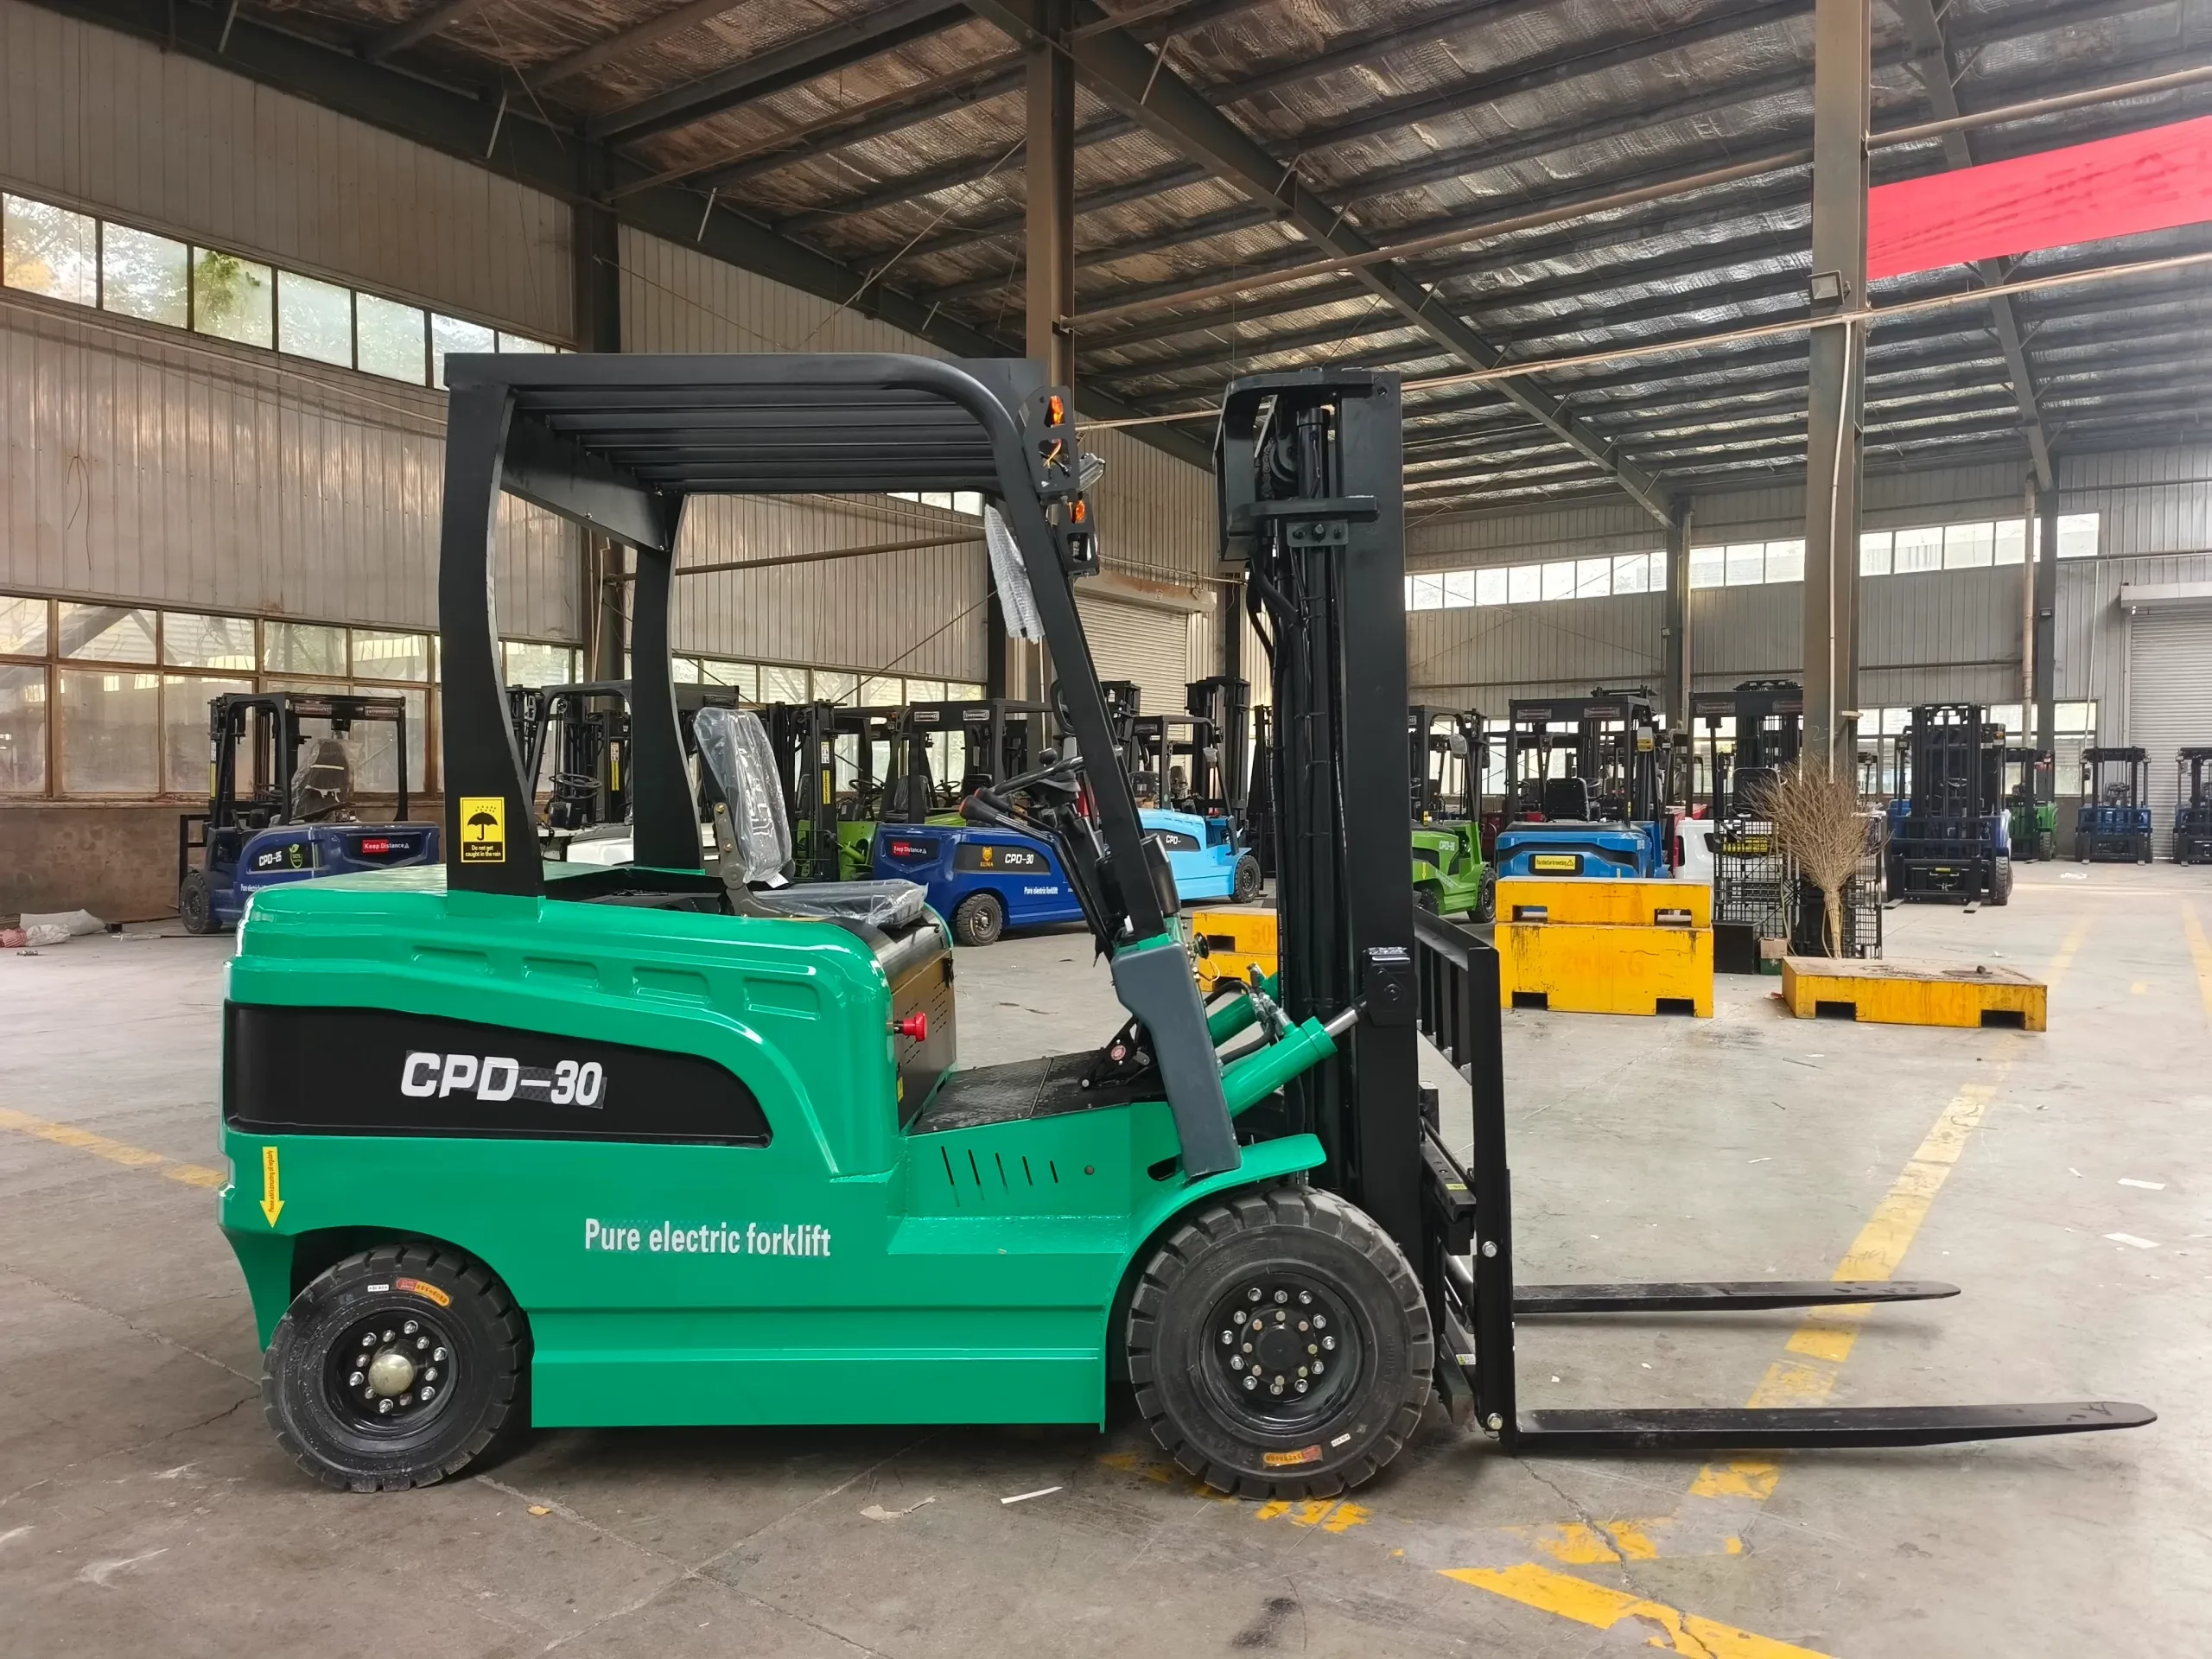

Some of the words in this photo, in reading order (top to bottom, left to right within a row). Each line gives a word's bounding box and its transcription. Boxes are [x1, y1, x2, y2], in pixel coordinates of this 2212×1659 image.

[1005, 854, 1034, 864] CPD-30
[1024, 886, 1033, 894] Pure
[401, 1052, 603, 1106] CPD-30
[585, 1218, 640, 1251] Pure
[649, 1221, 740, 1253] electric
[747, 1223, 831, 1256] forklift
